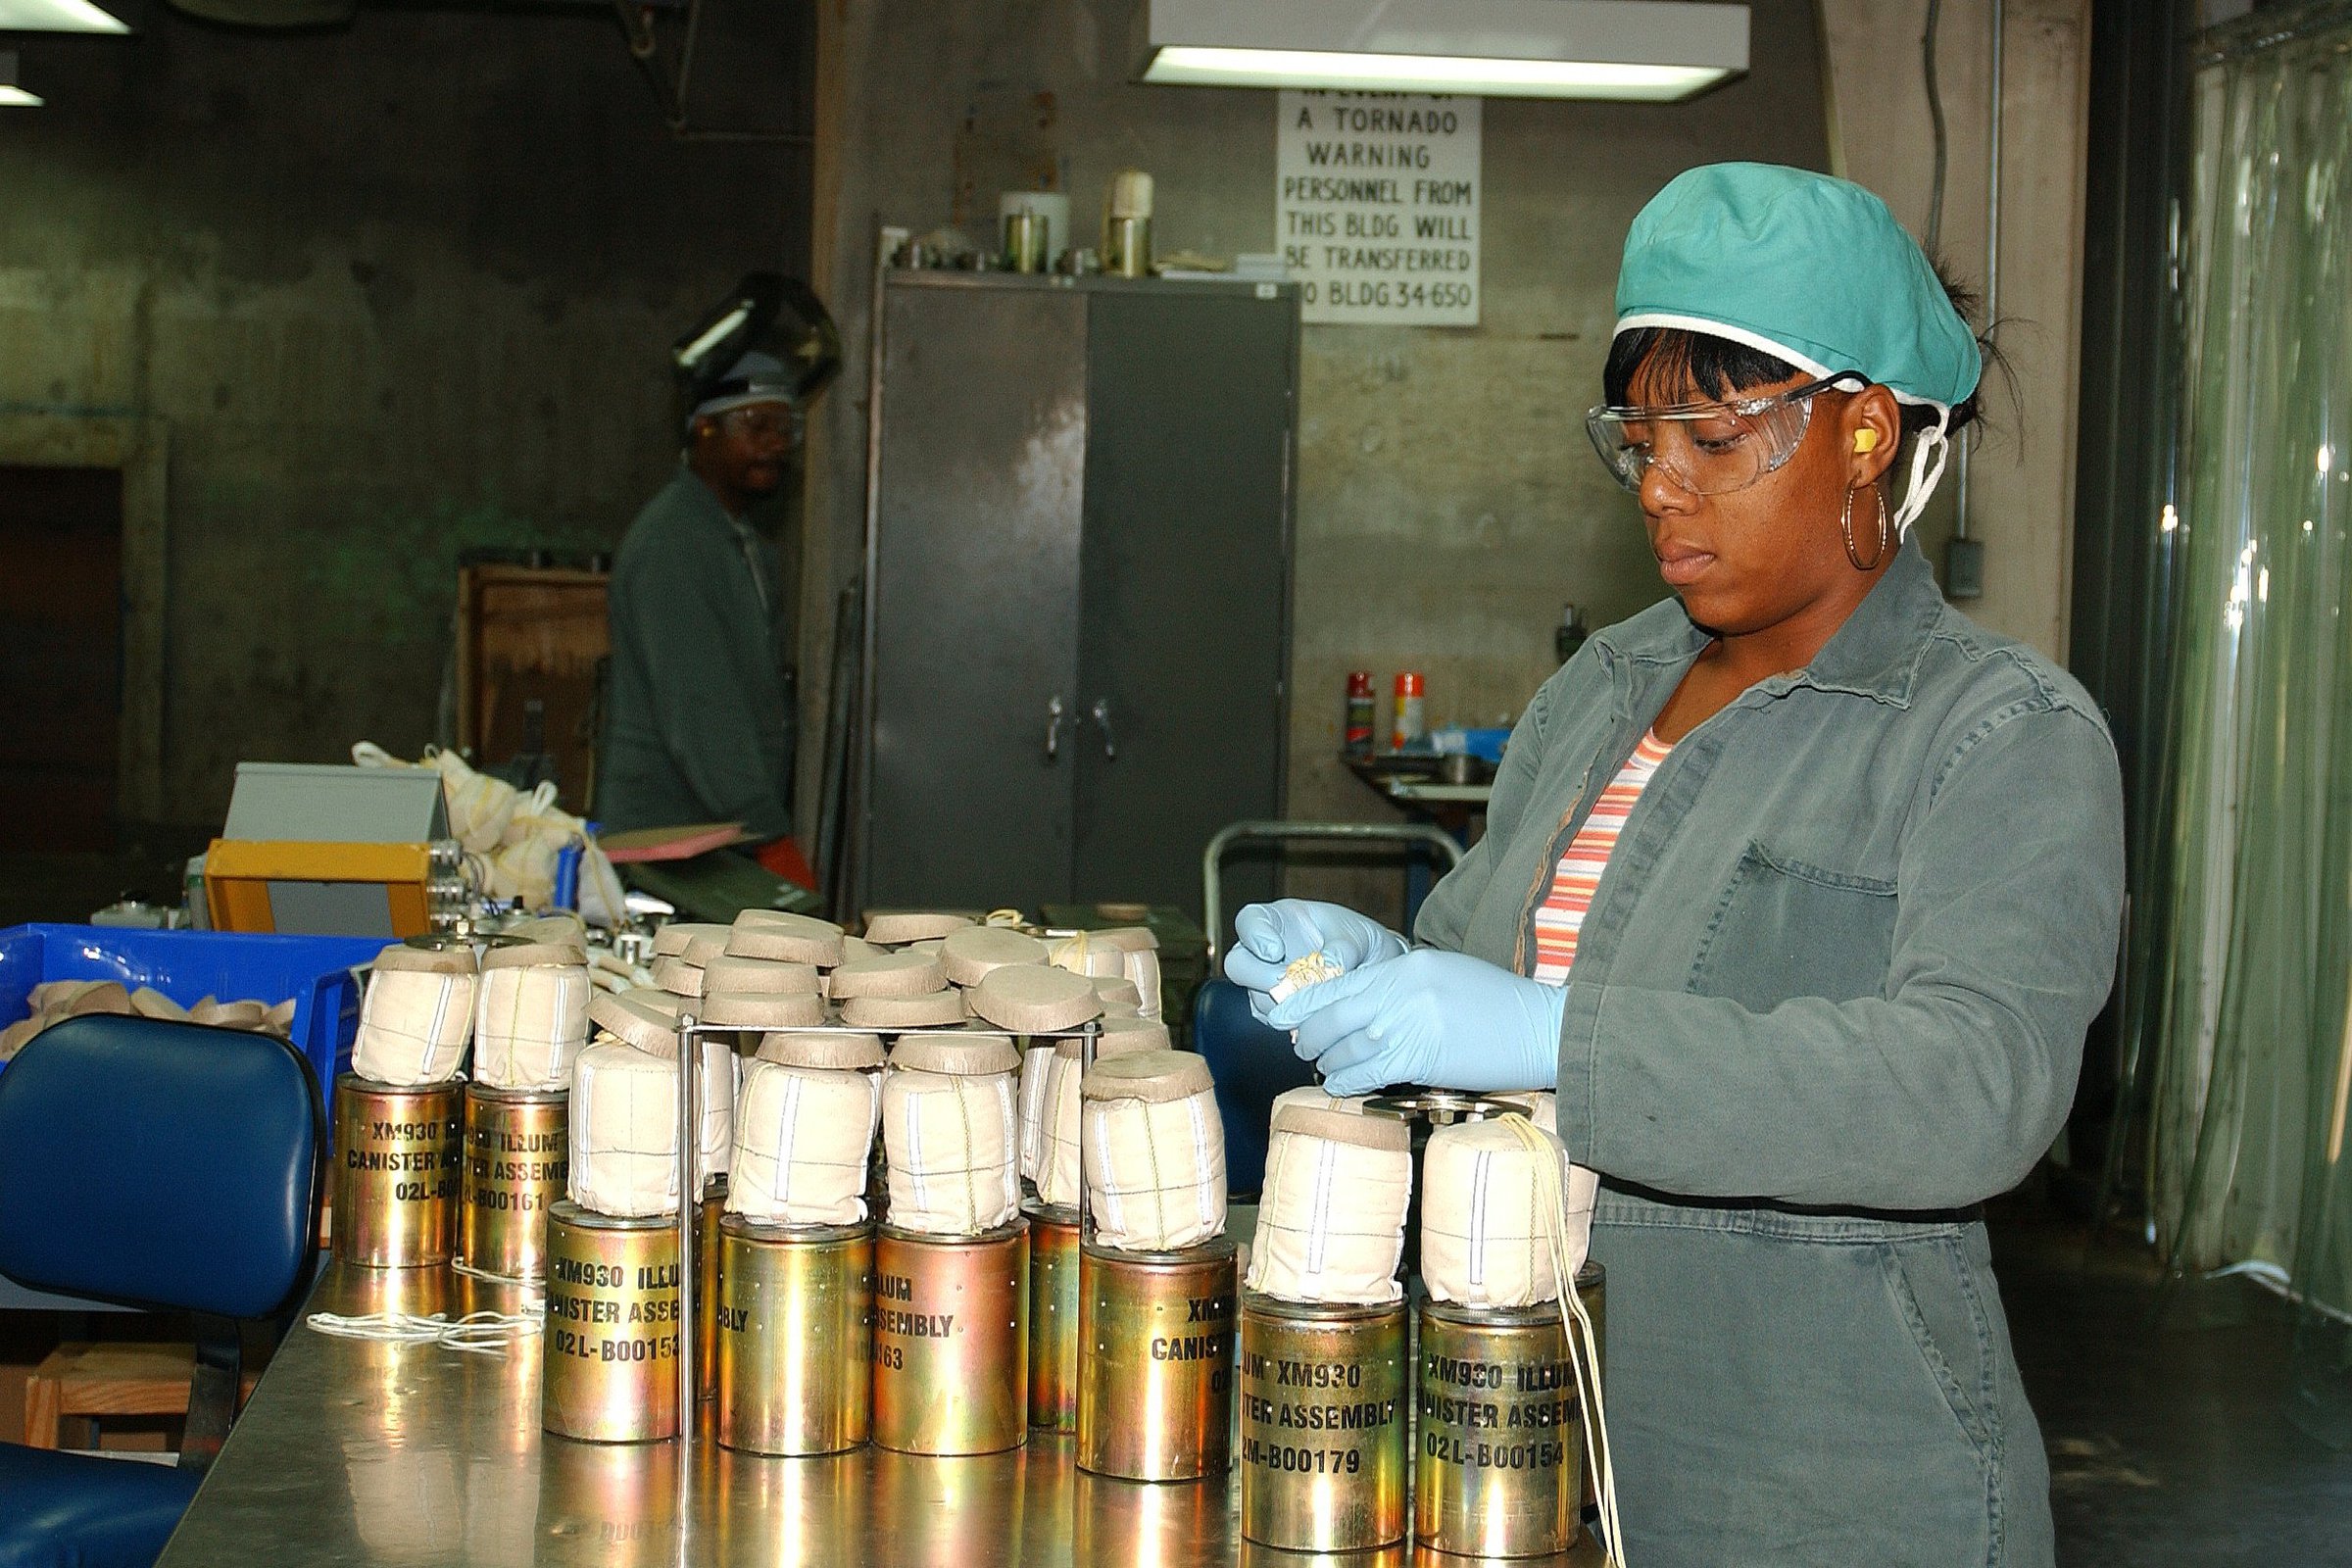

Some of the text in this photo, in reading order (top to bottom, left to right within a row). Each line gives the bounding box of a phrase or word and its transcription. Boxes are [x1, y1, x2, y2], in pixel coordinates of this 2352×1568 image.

[1297, 106, 1458, 134] A TORNADO
[1305, 141, 1431, 170] WARNING
[1284, 175, 1471, 205] PERSONNEL FROM
[1288, 211, 1471, 240] THIS BLDG WILL
[1284, 244, 1471, 271] BE TRANSFERRED
[1304, 281, 1318, 305] O
[1329, 280, 1390, 307] BLDG
[372, 1121, 437, 1141] XM930
[499, 1133, 560, 1152] ILLUM
[347, 1149, 436, 1171] CANISTER
[1152, 1335, 1221, 1362] CANIS
[1277, 1359, 1361, 1389] XM930
[1428, 1353, 1503, 1390] XM930
[1278, 1398, 1396, 1430] ASSEMBLY
[1427, 1432, 1564, 1469] 02L-B00154
